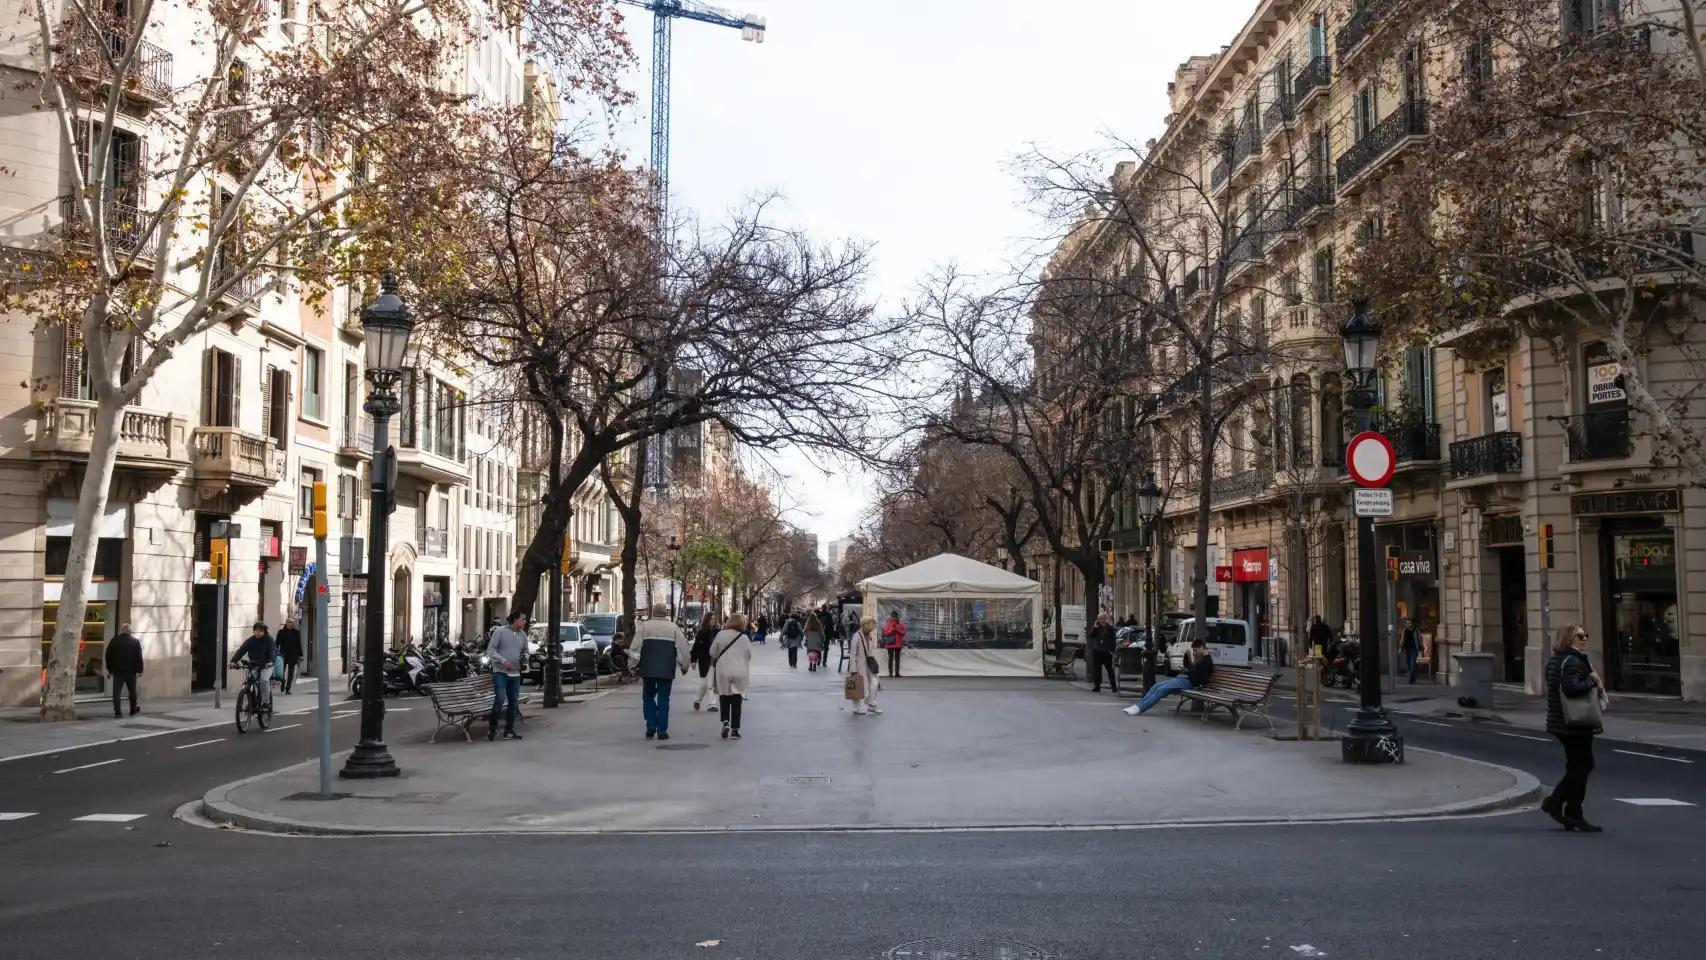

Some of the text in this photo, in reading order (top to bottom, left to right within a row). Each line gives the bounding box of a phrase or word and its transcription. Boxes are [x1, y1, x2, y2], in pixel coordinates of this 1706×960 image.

[1593, 365, 1617, 377] 100
[1593, 382, 1616, 392] OBRIN
[1592, 390, 1621, 401] PORTES
[1400, 558, 1430, 574] casa viva
